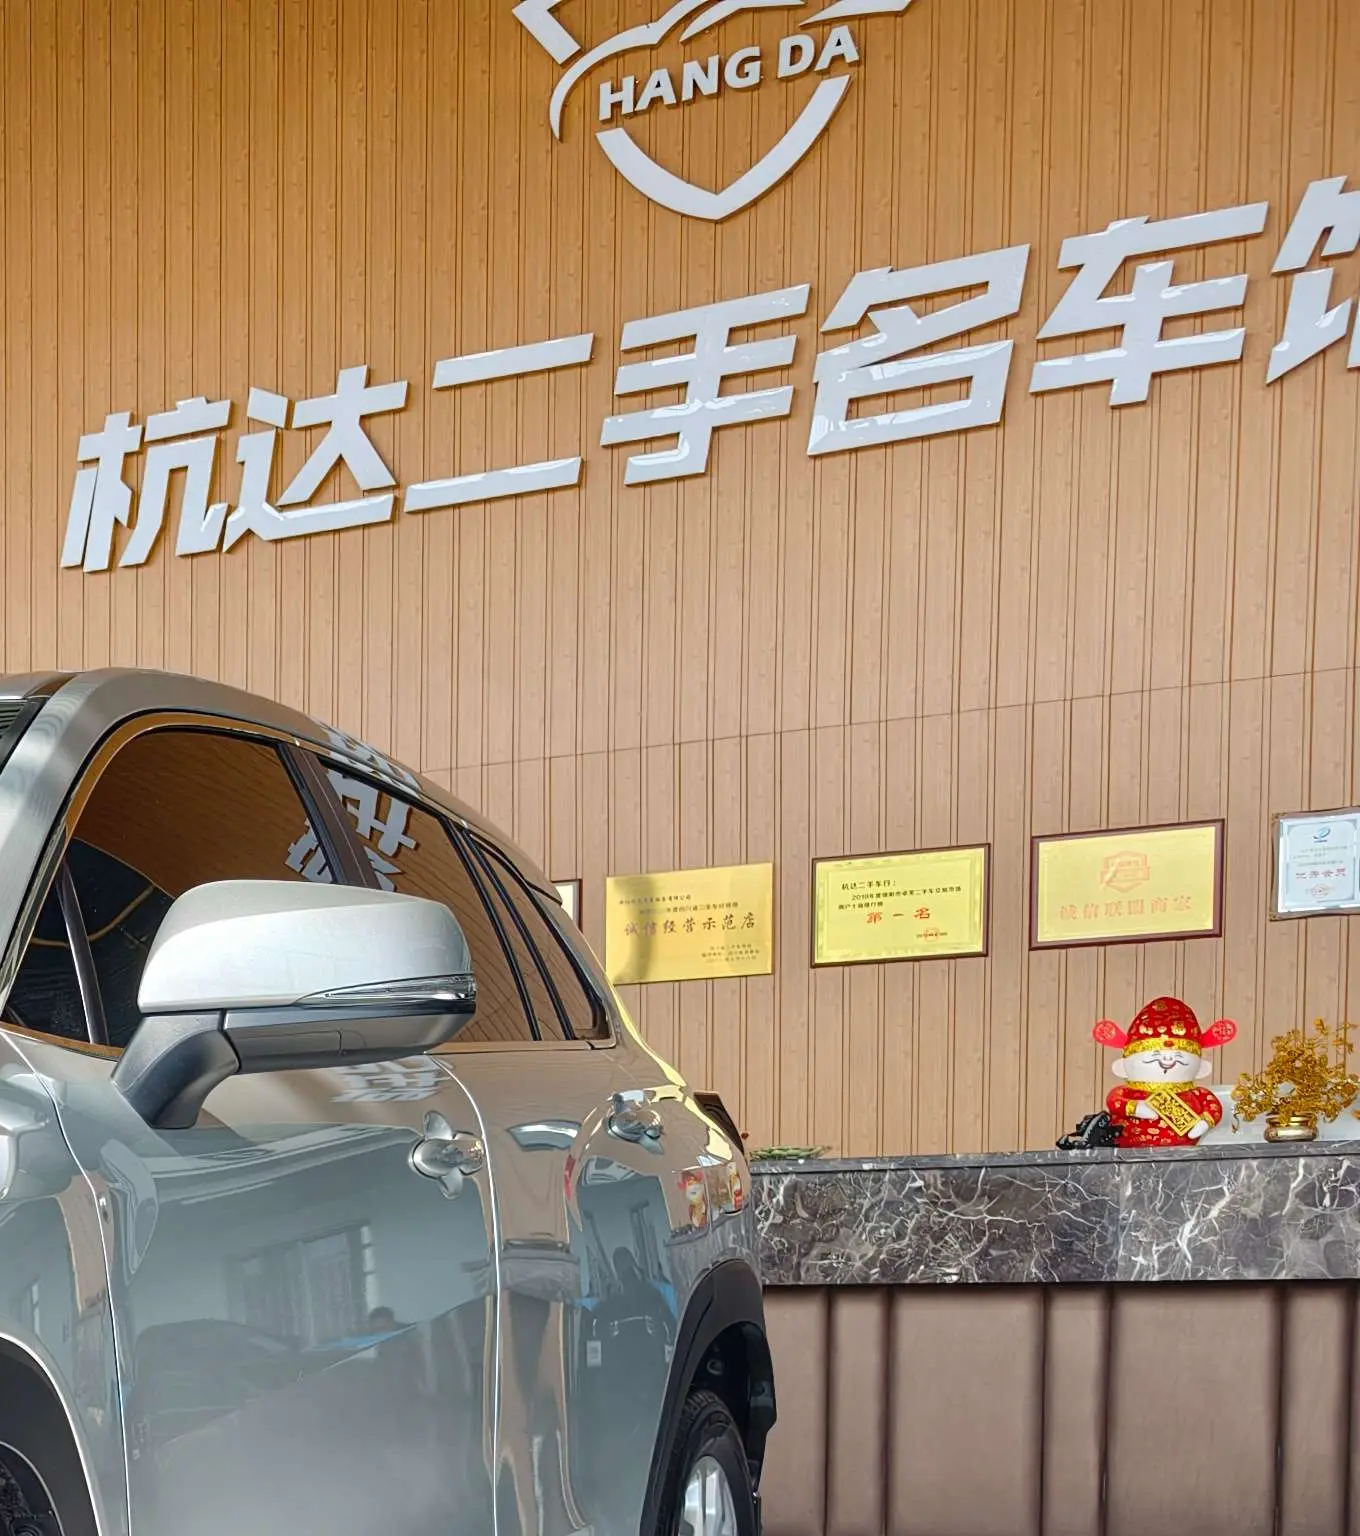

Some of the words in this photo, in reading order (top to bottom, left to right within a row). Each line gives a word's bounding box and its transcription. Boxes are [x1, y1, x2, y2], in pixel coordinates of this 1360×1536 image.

[598, 46, 762, 122] HANG
[777, 25, 861, 79] DA
[866, 907, 931, 924] 第一名
[1059, 895, 1192, 920] 诚信联盟商家
[624, 911, 756, 937] 诚信经营示范店
